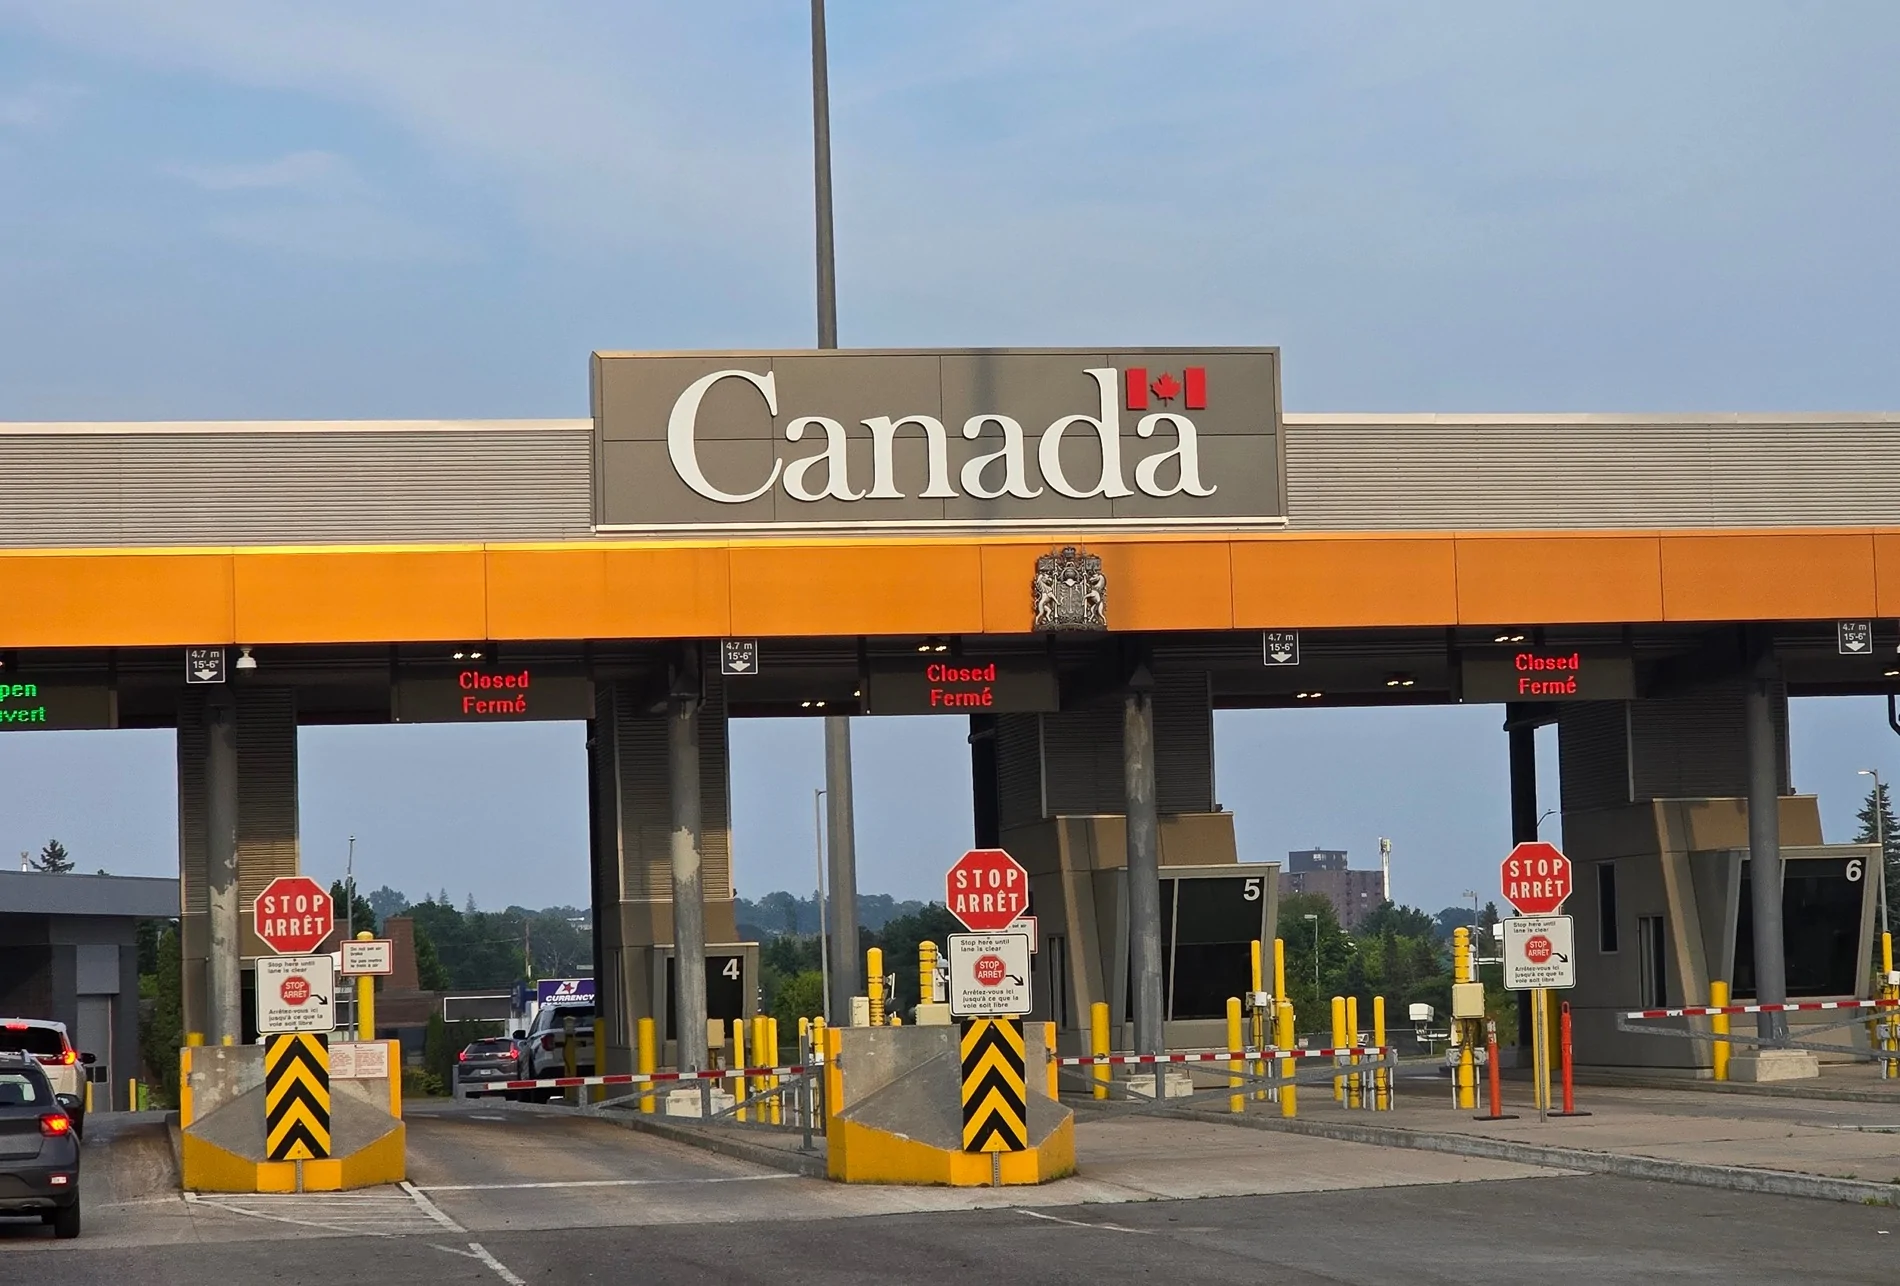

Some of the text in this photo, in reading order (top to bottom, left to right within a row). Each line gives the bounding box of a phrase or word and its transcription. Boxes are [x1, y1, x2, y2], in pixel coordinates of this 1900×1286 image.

[667, 368, 1218, 504] Canada
[1514, 654, 1579, 671] Closed
[459, 671, 529, 689] Closed
[927, 664, 996, 681] Closed
[0, 684, 37, 702] pen
[1518, 675, 1577, 694] Fermé
[462, 694, 526, 713] Fermé
[931, 687, 993, 706] Fermé
[0, 706, 46, 722] vert
[1510, 859, 1563, 877] STOP
[1846, 860, 1861, 881] 6
[956, 869, 1018, 888] STOP
[1244, 879, 1260, 900] 5
[1510, 878, 1564, 899] ARRÊT
[264, 895, 324, 914] STOP
[956, 890, 1018, 913] ARRÊT
[264, 915, 324, 936] ARRÊT
[723, 959, 739, 980] 4
[978, 968, 1002, 978] ARRÊT
[980, 961, 1000, 969] STOP
[283, 988, 307, 998] ARRÊT
